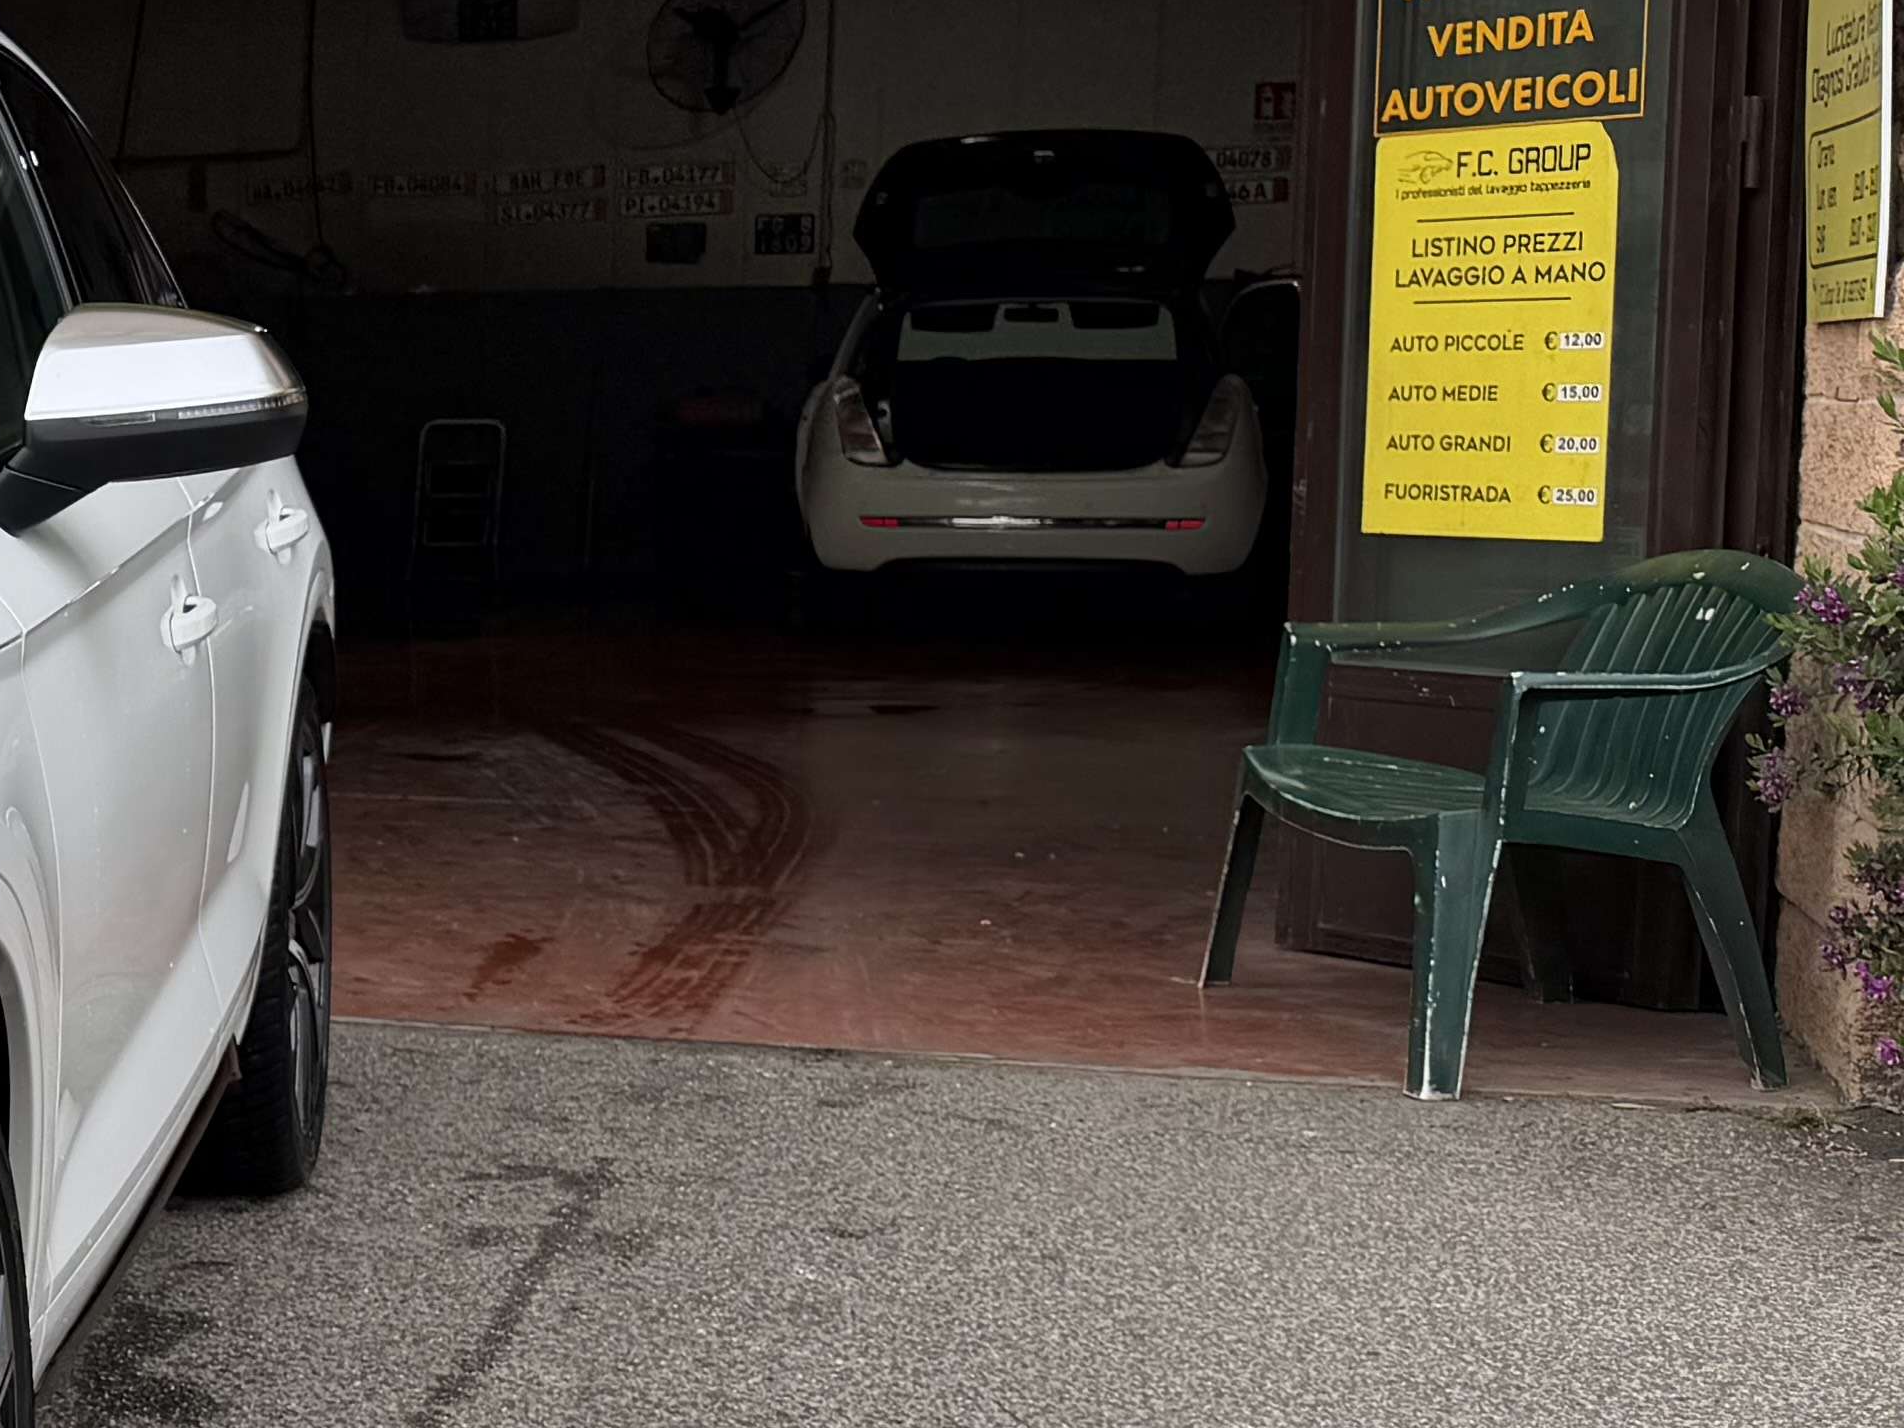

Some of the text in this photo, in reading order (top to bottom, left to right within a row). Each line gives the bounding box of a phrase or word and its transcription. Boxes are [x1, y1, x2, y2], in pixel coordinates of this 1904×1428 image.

[1427, 9, 1595, 59] VENDITA
[1381, 67, 1638, 123] AUTOVEICOLI
[1456, 143, 1591, 179] F.C. GROUP
[1401, 184, 1466, 201] professionisti
[1486, 182, 1527, 196] lavaggio
[1412, 231, 1583, 258] LISTINO PREZZI
[1395, 261, 1606, 288] LAVAGGIO A MANO
[1390, 335, 1439, 352] AUTO
[1444, 334, 1525, 351] PICCOLE
[1564, 333, 1602, 348] 12,00
[1388, 385, 1437, 402] AUTO
[1442, 385, 1498, 402] MEDIE
[1561, 386, 1600, 401] 15,00
[1386, 434, 1435, 452] AUTO
[1439, 435, 1511, 452] GRANDI
[1557, 437, 1597, 452] 20,00
[1384, 483, 1511, 503] FUORISTRADA
[1555, 488, 1595, 503] 25,00
